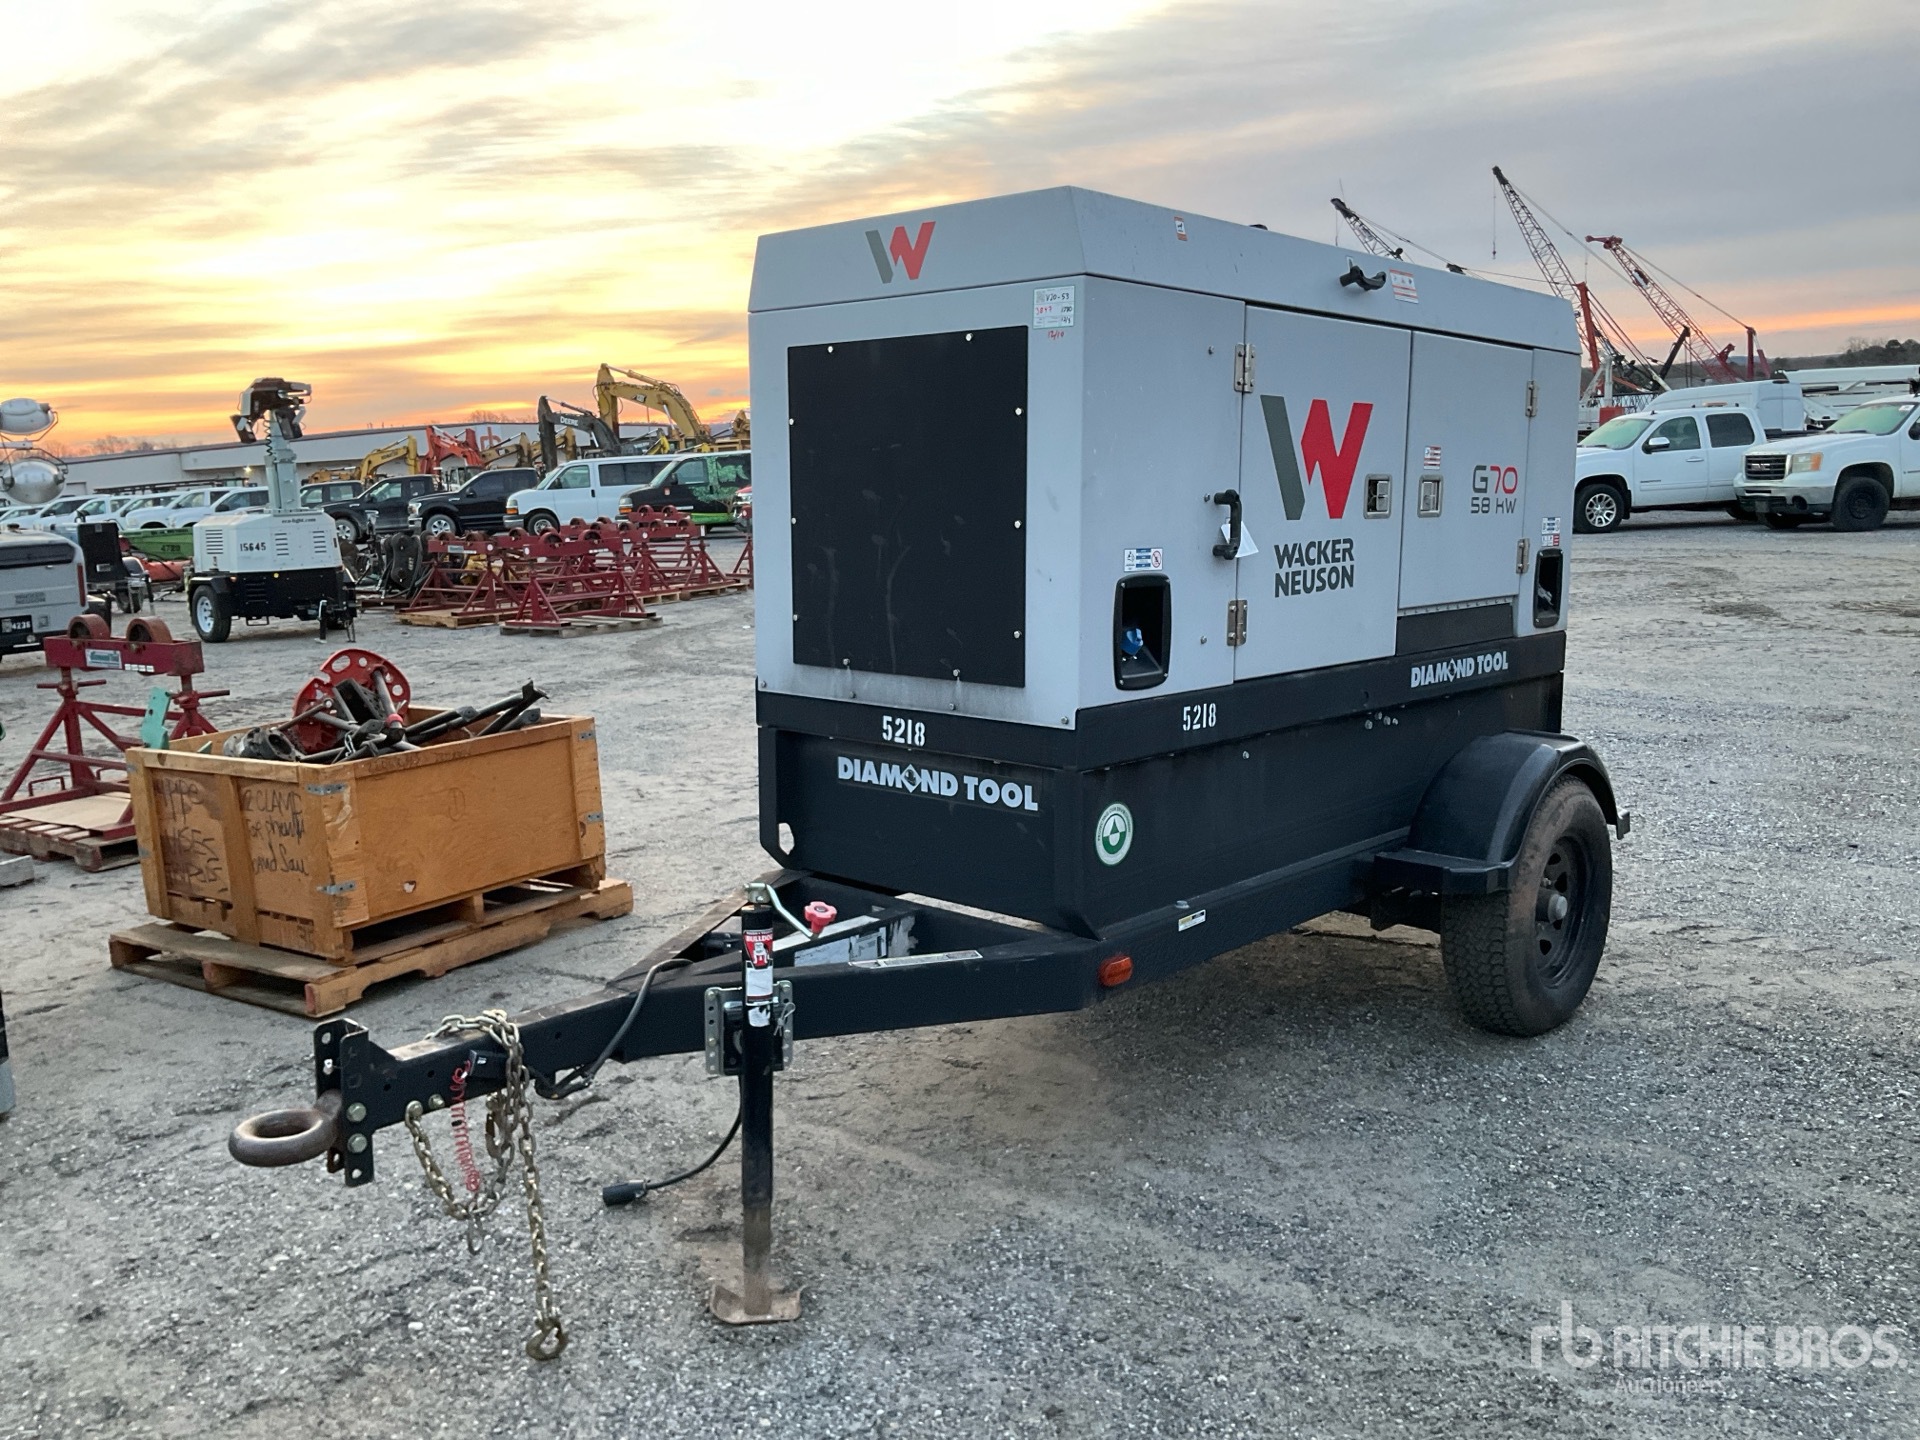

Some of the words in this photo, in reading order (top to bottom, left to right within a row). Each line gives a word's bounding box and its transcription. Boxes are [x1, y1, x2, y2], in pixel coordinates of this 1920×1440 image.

[560, 416, 578, 426] DEERE
[1260, 395, 1373, 520] W
[1473, 465, 1518, 494] G70
[1471, 497, 1490, 513] 58
[240, 542, 266, 551] 15645
[1274, 538, 1354, 569] WACKER
[1275, 565, 1354, 598] NEUSON
[1411, 658, 1475, 688] DIAMOND
[1477, 651, 1509, 675] TOOL
[882, 715, 926, 747] 5218
[1183, 703, 1217, 731] 5218
[837, 756, 959, 798] DIAMOND
[963, 776, 1039, 812] TOOL
